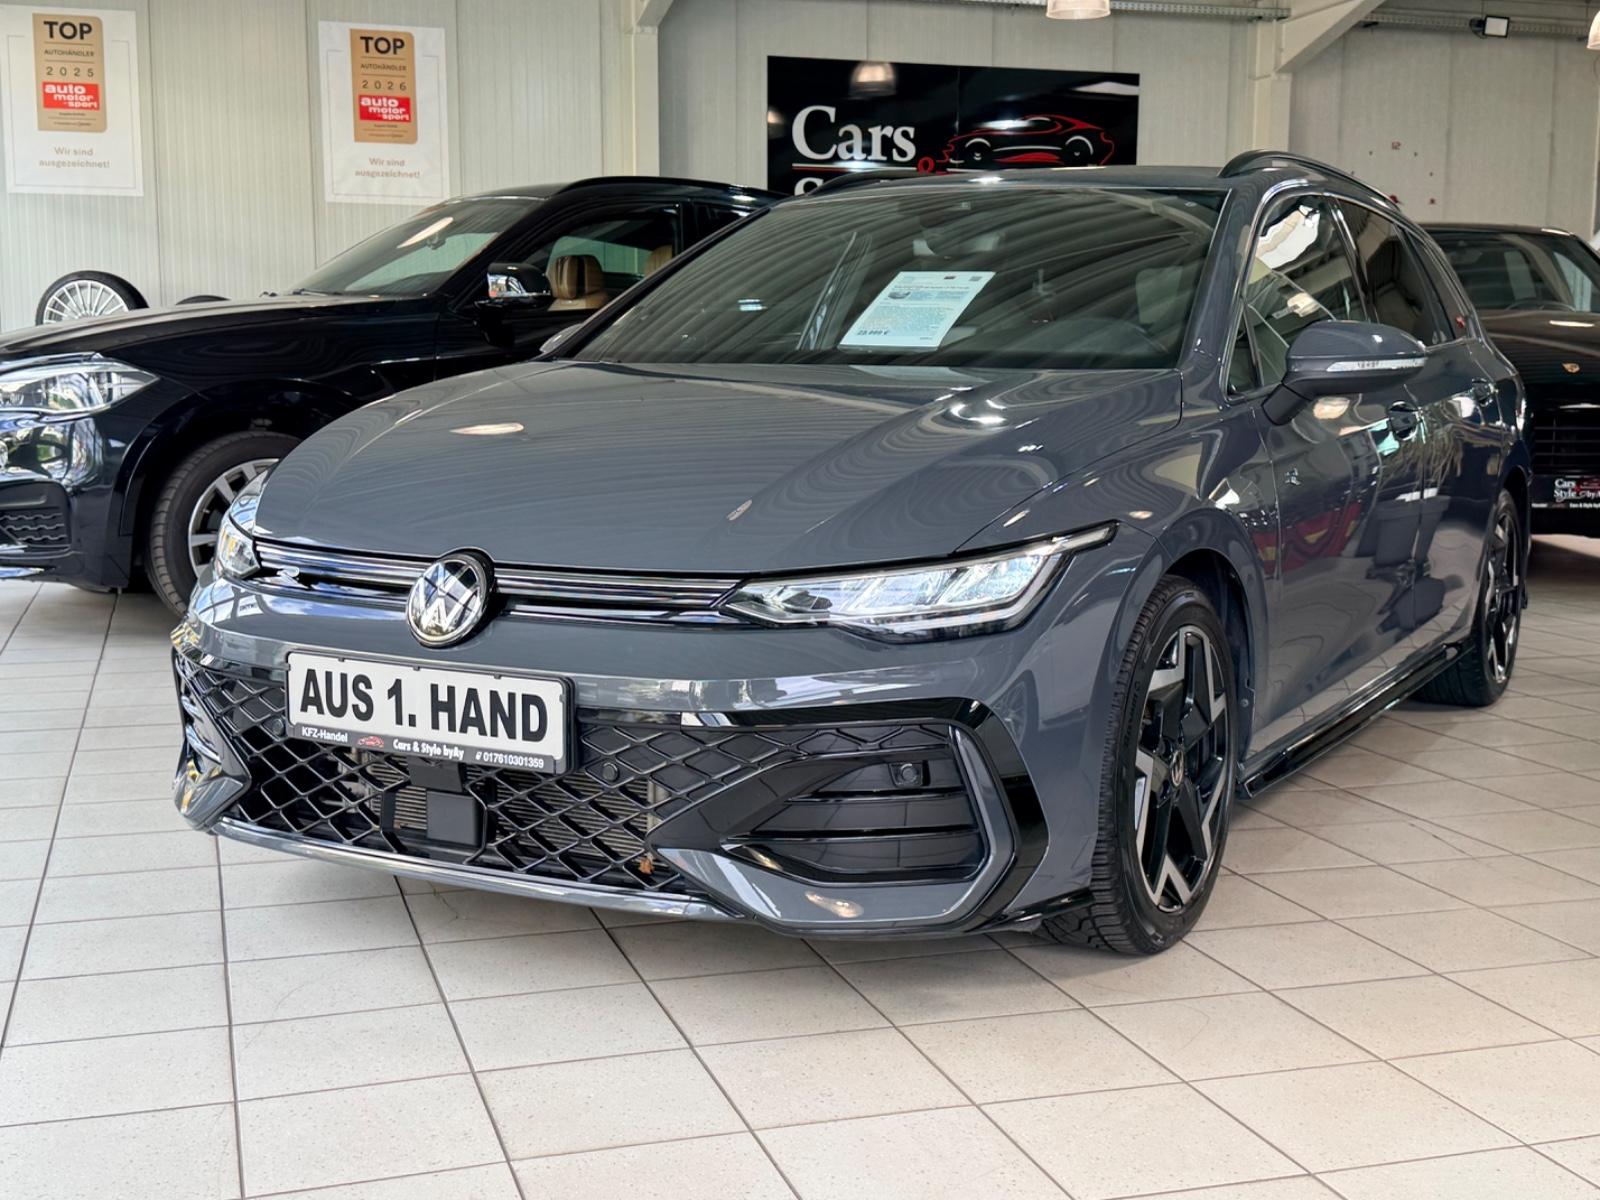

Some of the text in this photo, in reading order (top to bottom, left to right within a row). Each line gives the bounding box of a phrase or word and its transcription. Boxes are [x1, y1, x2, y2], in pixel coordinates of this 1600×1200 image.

[43, 20, 92, 40] TOP
[359, 36, 405, 55] TOP
[44, 49, 95, 57] AUTOHÄNDLER
[46, 66, 94, 77] 2025
[360, 63, 407, 71] AUTOHÄNDLER
[44, 84, 86, 94] auto
[362, 80, 407, 91] 2026
[53, 94, 94, 102] motor
[361, 97, 399, 107] auto
[68, 101, 98, 109] sport
[368, 106, 406, 114] motor
[382, 113, 410, 121] sport
[791, 105, 917, 162] Cars
[54, 147, 94, 157] Wir sind
[38, 160, 111, 169] ausgezeichnet!
[368, 157, 406, 167] Wir sind
[300, 668, 548, 742] AUS 1. HAND
[301, 725, 348, 743] KFZ-Handel
[392, 738, 411, 752] Cars
[412, 741, 420, 753] &
[421, 742, 442, 757] Style
